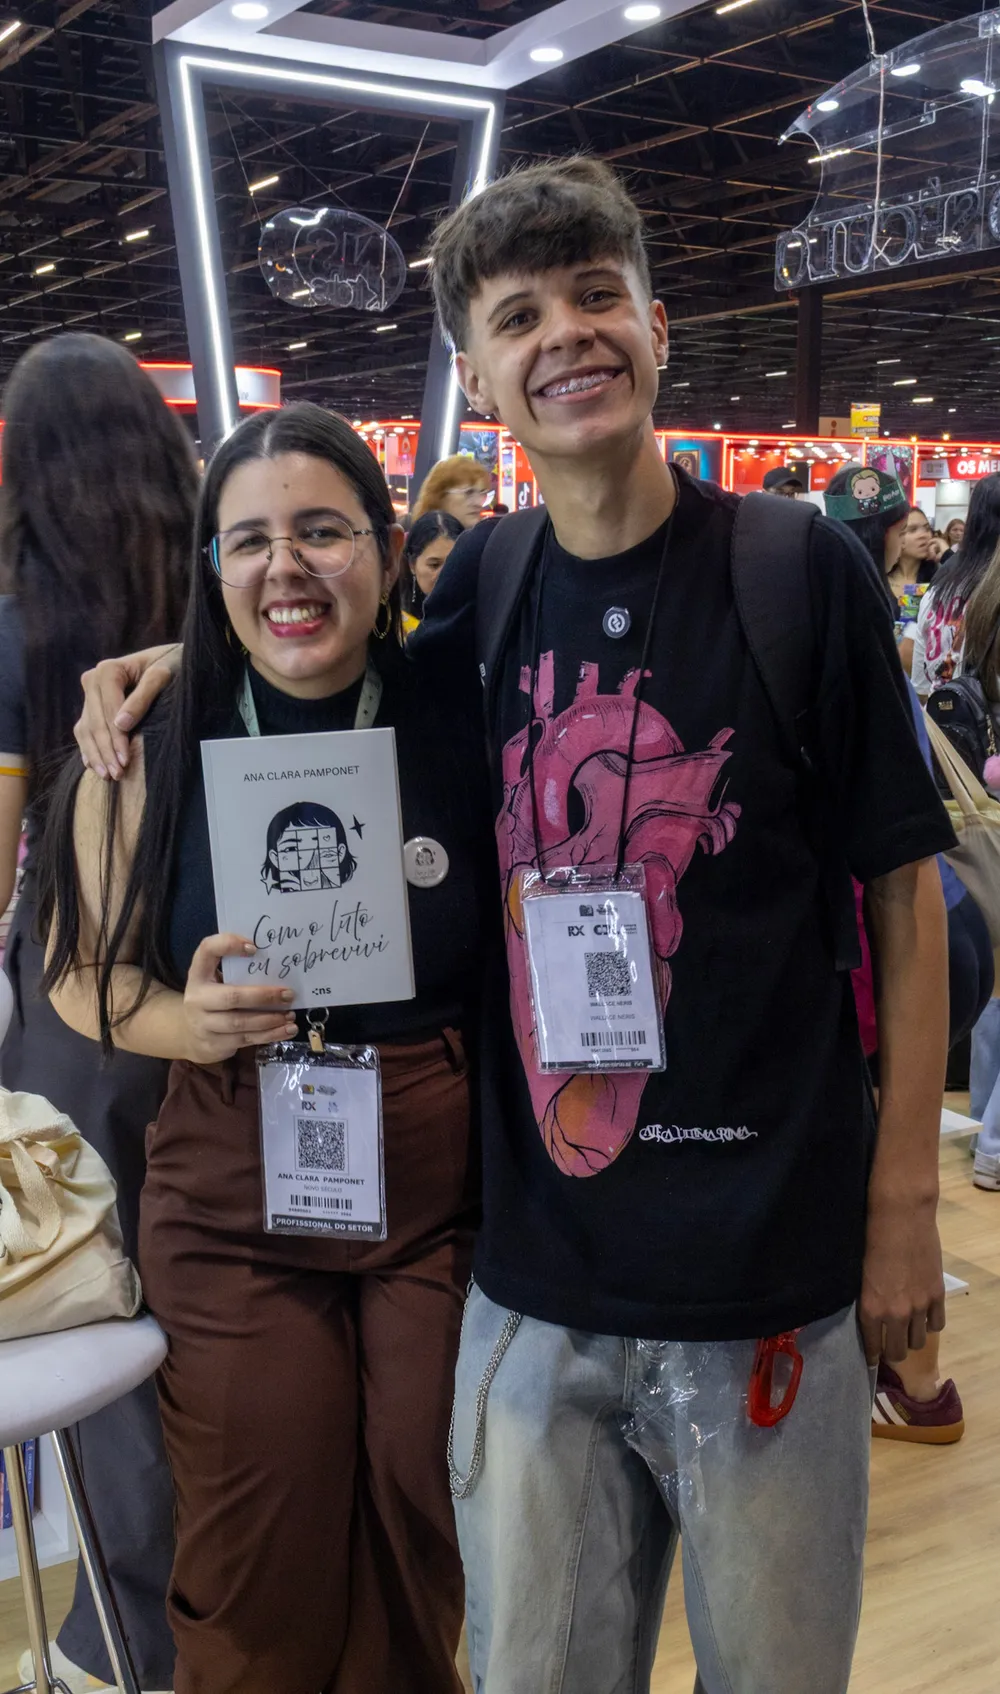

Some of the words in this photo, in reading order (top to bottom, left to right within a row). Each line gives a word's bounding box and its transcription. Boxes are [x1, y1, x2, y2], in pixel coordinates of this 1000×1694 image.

[957, 460, 976, 475] OS
[243, 772, 265, 782] ANA
[267, 769, 302, 781] CLARA
[303, 765, 360, 778] PAMPONET
[253, 914, 305, 950] Com
[308, 921, 324, 936] o
[330, 899, 375, 942] luto
[568, 925, 585, 937] RX
[247, 957, 271, 976] eu
[278, 934, 390, 979] sobrevivi
[301, 1101, 317, 1111] RX
[277, 1173, 293, 1181] ANA
[295, 1174, 320, 1182] CLARA
[323, 1177, 365, 1186] PAMPONET
[276, 1217, 333, 1229] PROFISSIONAL
[334, 1221, 346, 1231] DO
[347, 1223, 374, 1233] SETOR
